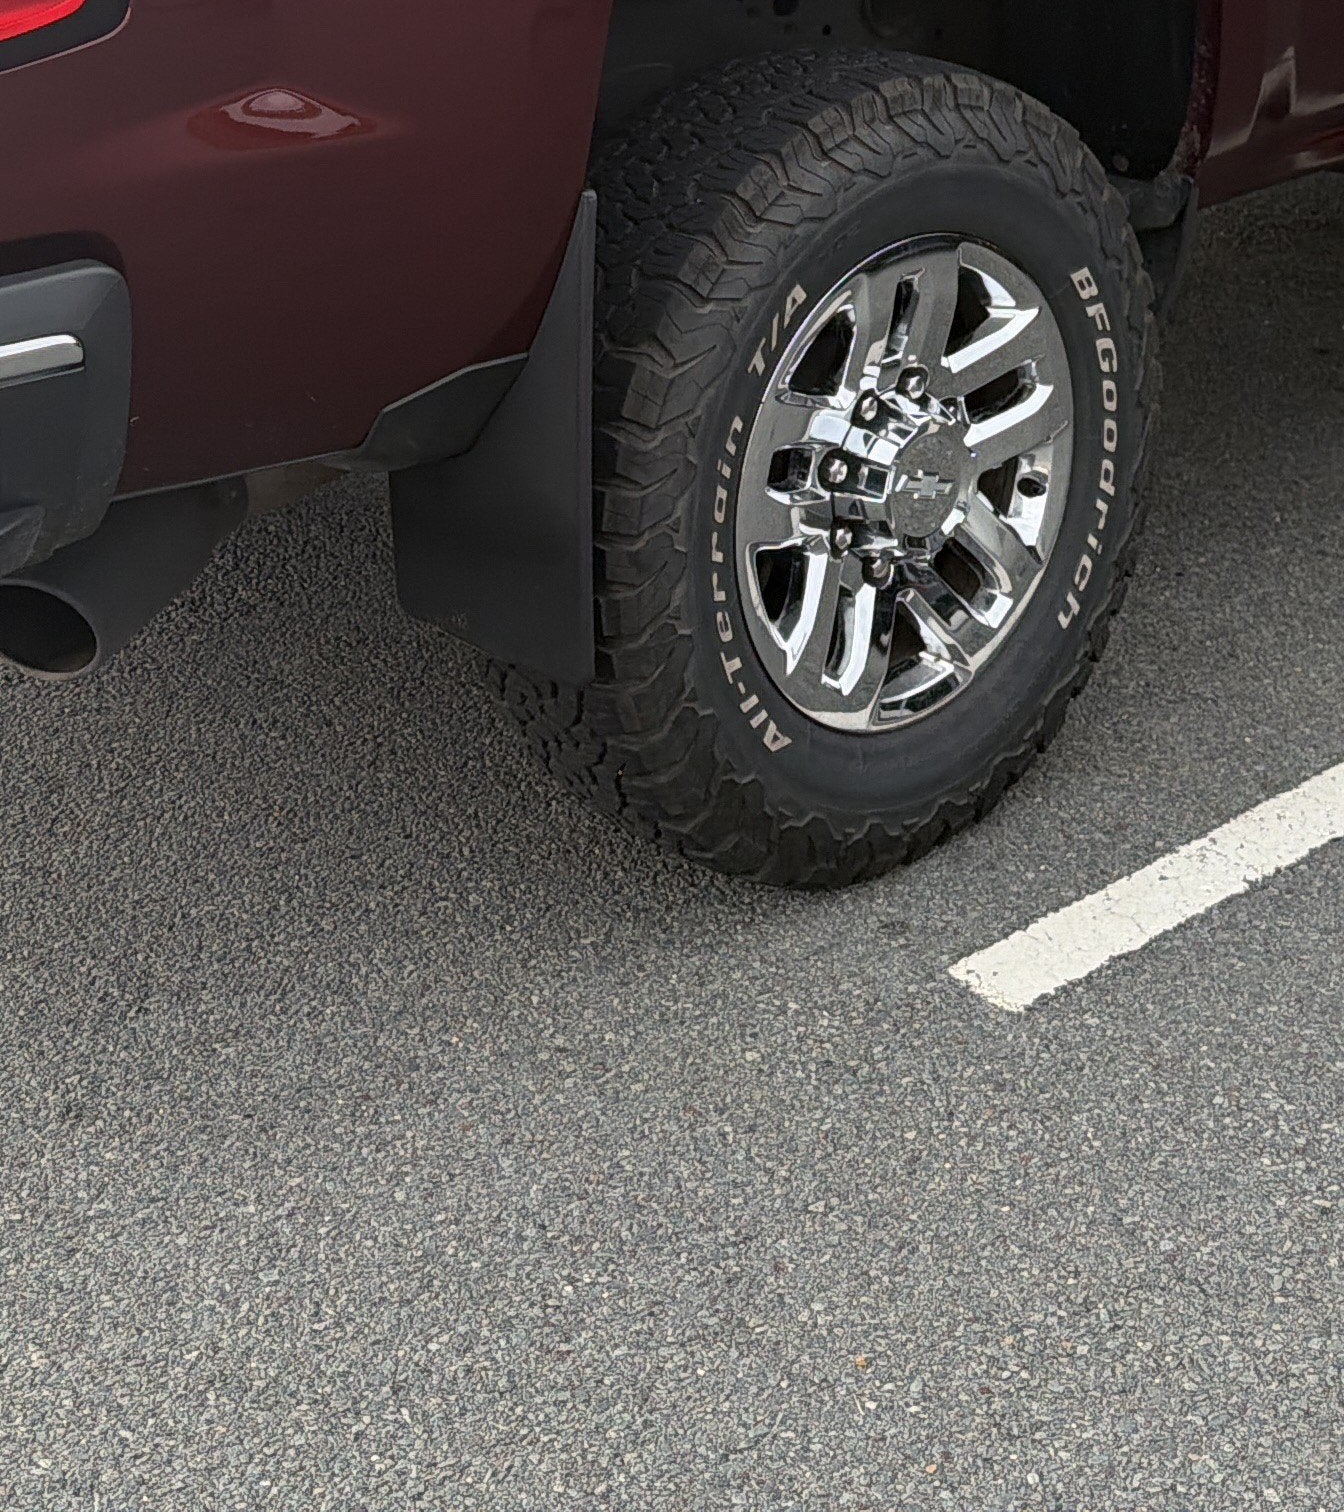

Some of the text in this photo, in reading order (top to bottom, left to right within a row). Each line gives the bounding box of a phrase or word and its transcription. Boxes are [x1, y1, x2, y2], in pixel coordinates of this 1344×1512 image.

[747, 283, 809, 378] T/A
[1057, 266, 1118, 630] BFGoodrich
[711, 413, 793, 754] All-Terrain
